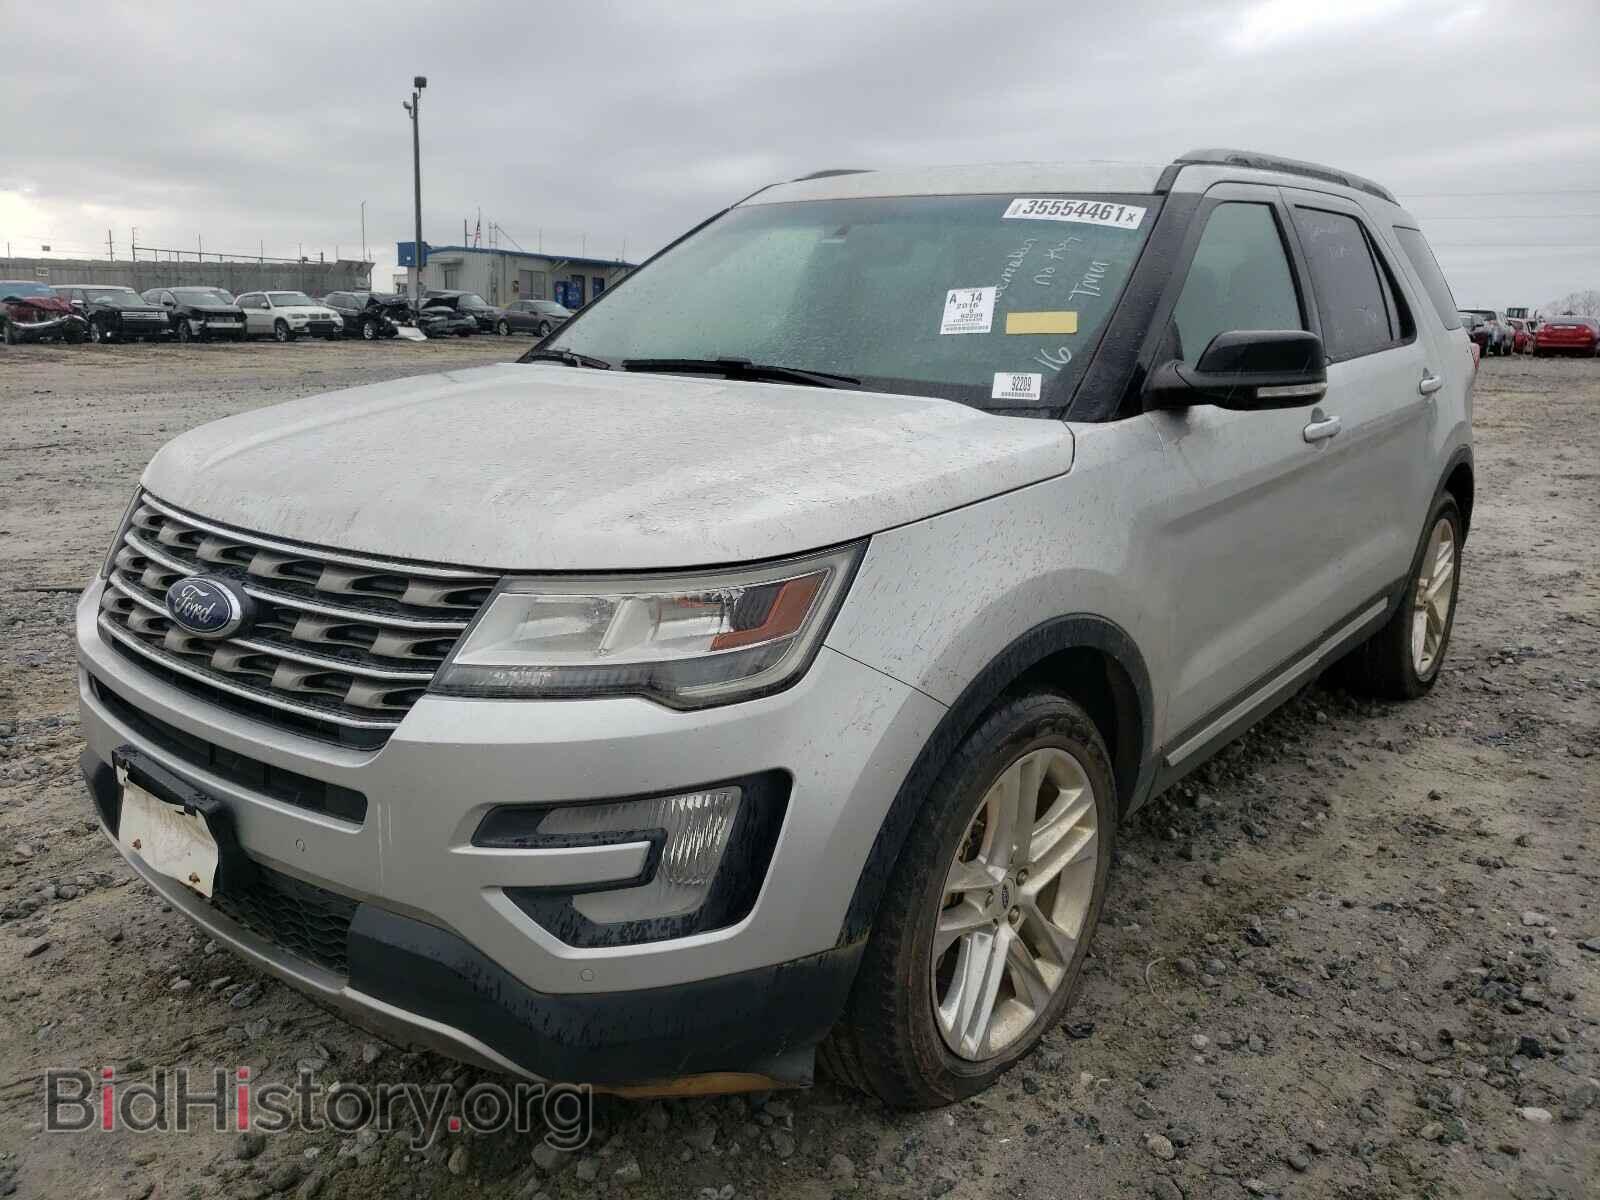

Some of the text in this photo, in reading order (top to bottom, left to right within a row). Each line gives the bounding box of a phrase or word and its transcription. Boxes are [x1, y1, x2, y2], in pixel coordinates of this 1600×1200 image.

[1022, 200, 1126, 222] 35554461
[949, 292, 983, 305] A 14
[1033, 347, 1072, 371] 16
[1011, 376, 1032, 391] 92209
[174, 584, 216, 624] Ford
